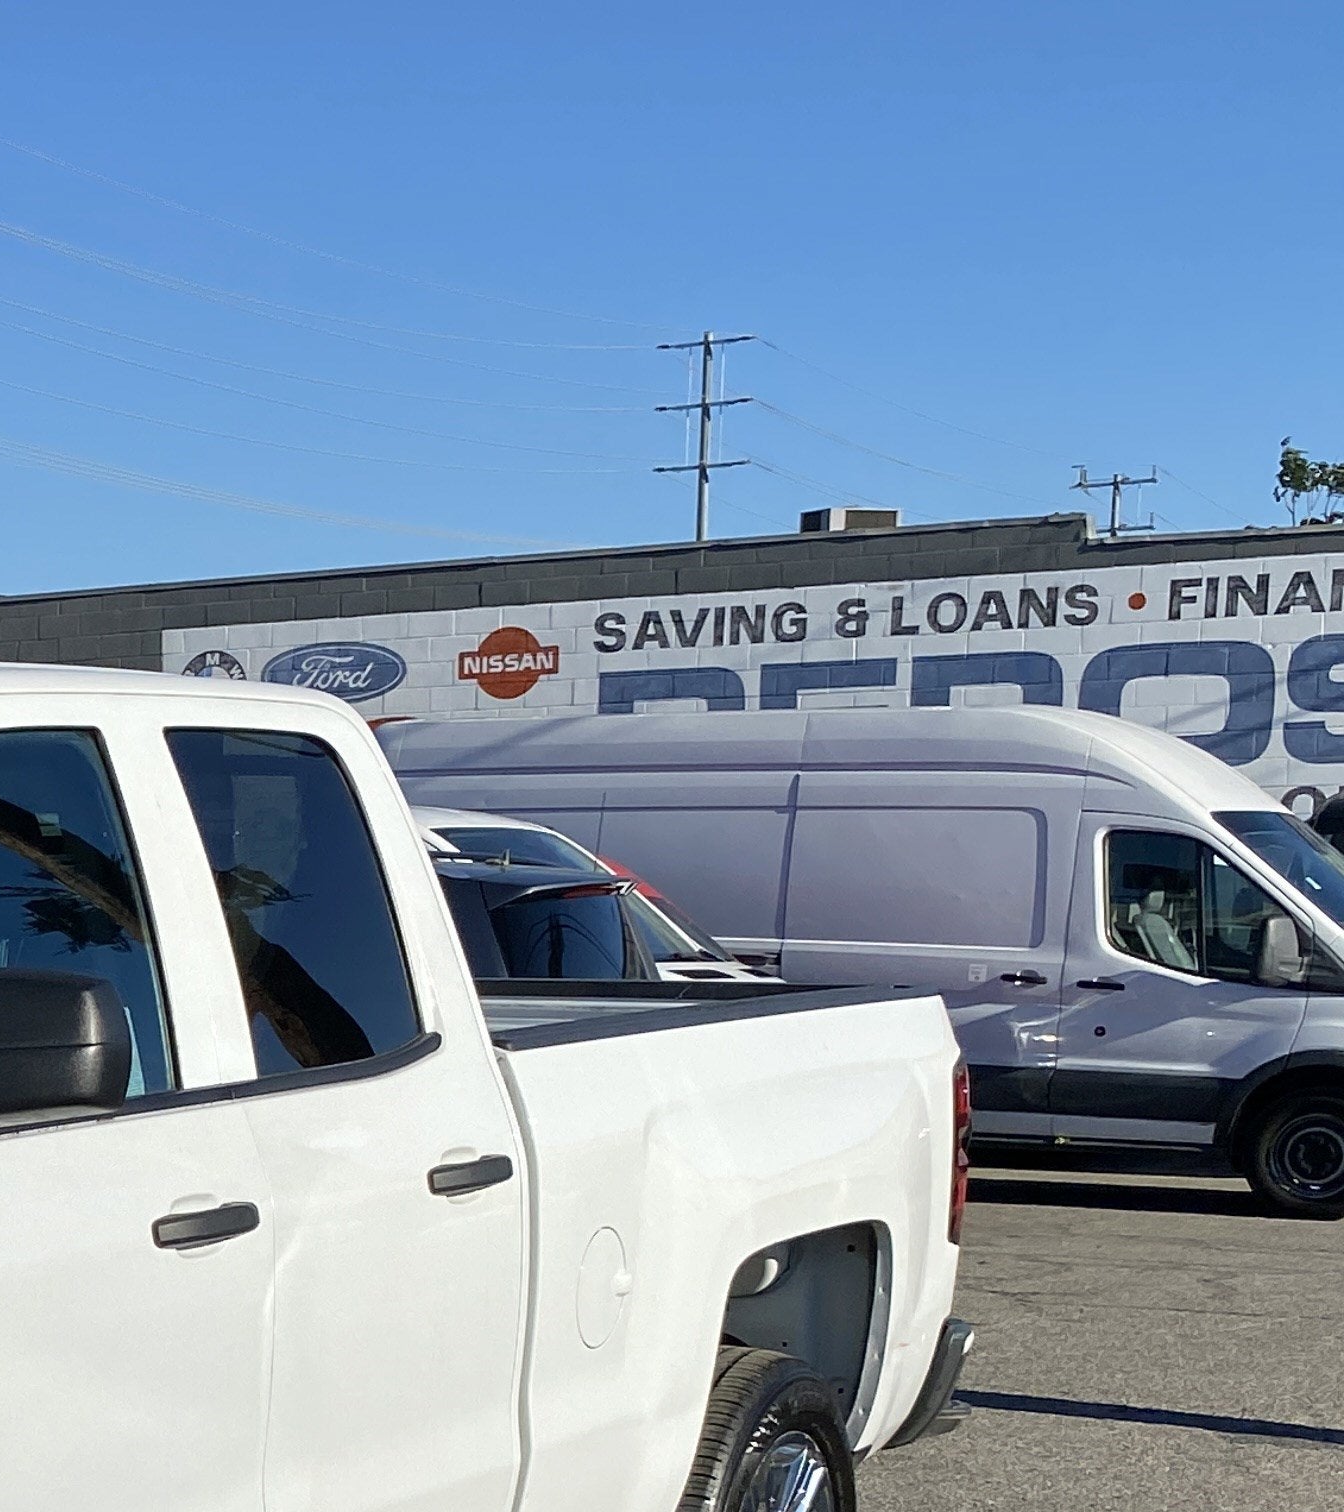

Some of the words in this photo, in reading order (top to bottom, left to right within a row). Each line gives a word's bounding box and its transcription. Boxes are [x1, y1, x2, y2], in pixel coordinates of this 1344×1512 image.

[592, 597, 809, 654] SAVING
[834, 597, 870, 640] &
[889, 582, 1101, 637] LOANS
[182, 652, 246, 680] MW
[293, 654, 373, 689] Ford
[462, 651, 556, 676] NISSAN
